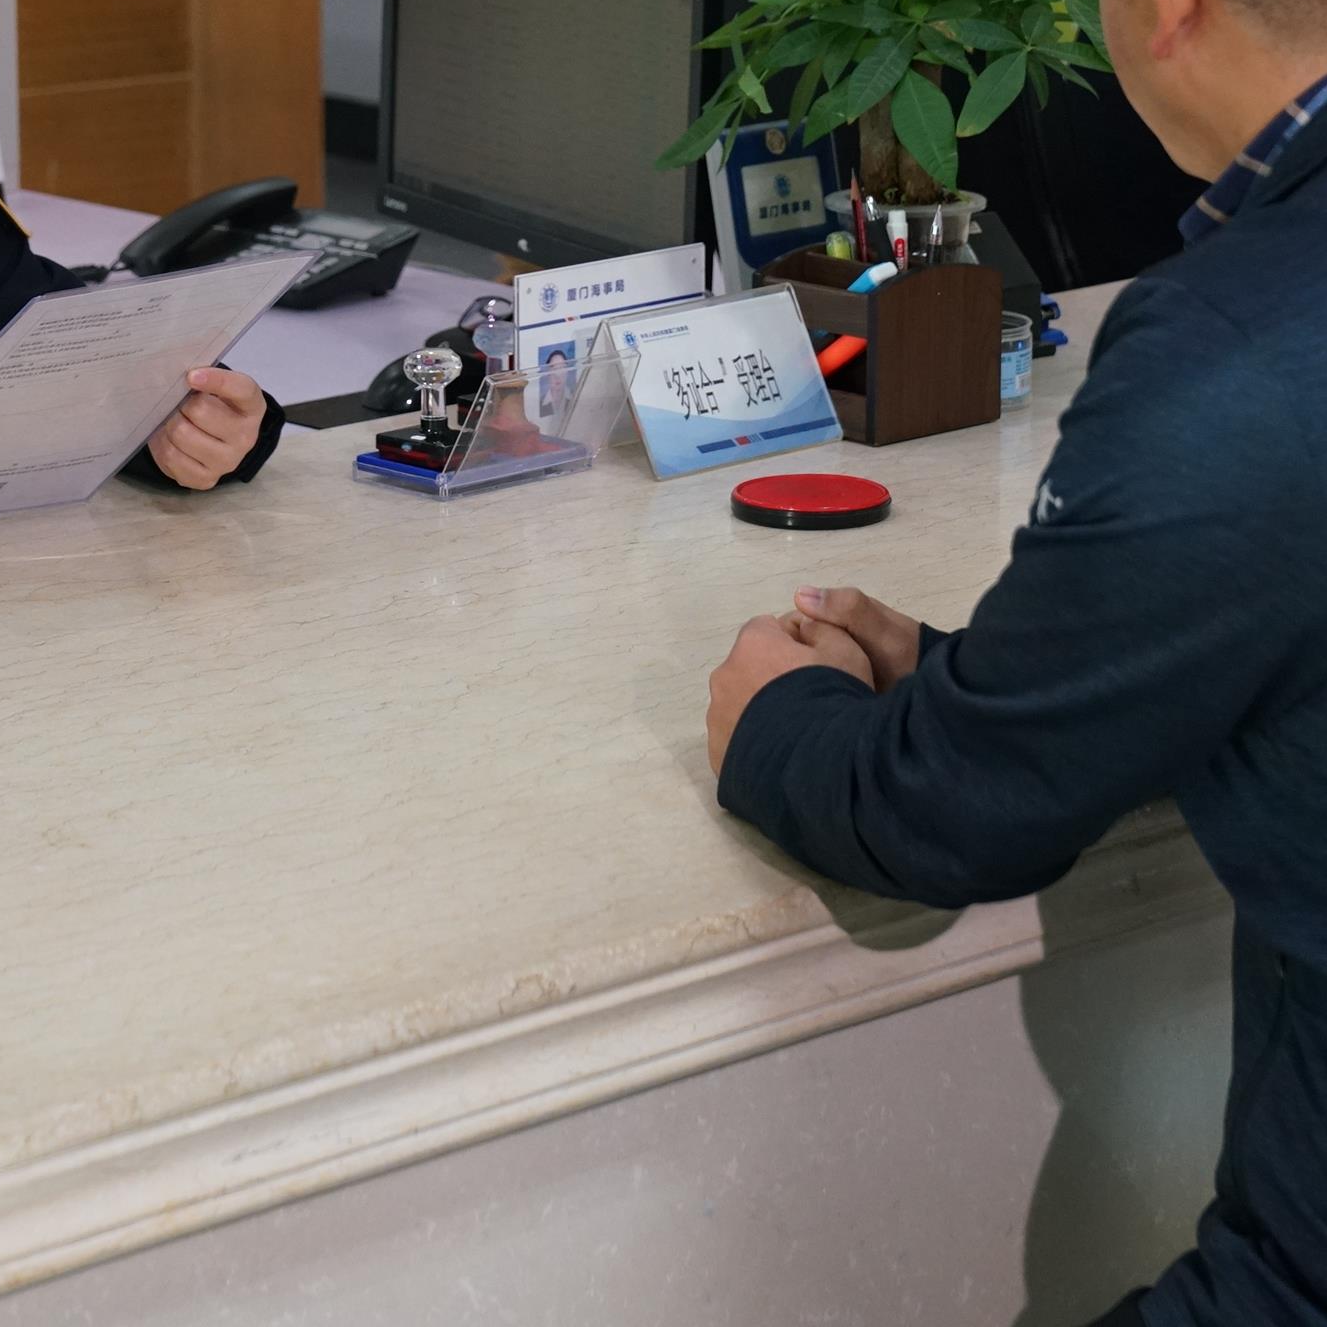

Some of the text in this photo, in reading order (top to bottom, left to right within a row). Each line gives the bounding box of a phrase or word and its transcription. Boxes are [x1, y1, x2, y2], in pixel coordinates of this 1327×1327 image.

[566, 279, 625, 302] 厦门海事局
